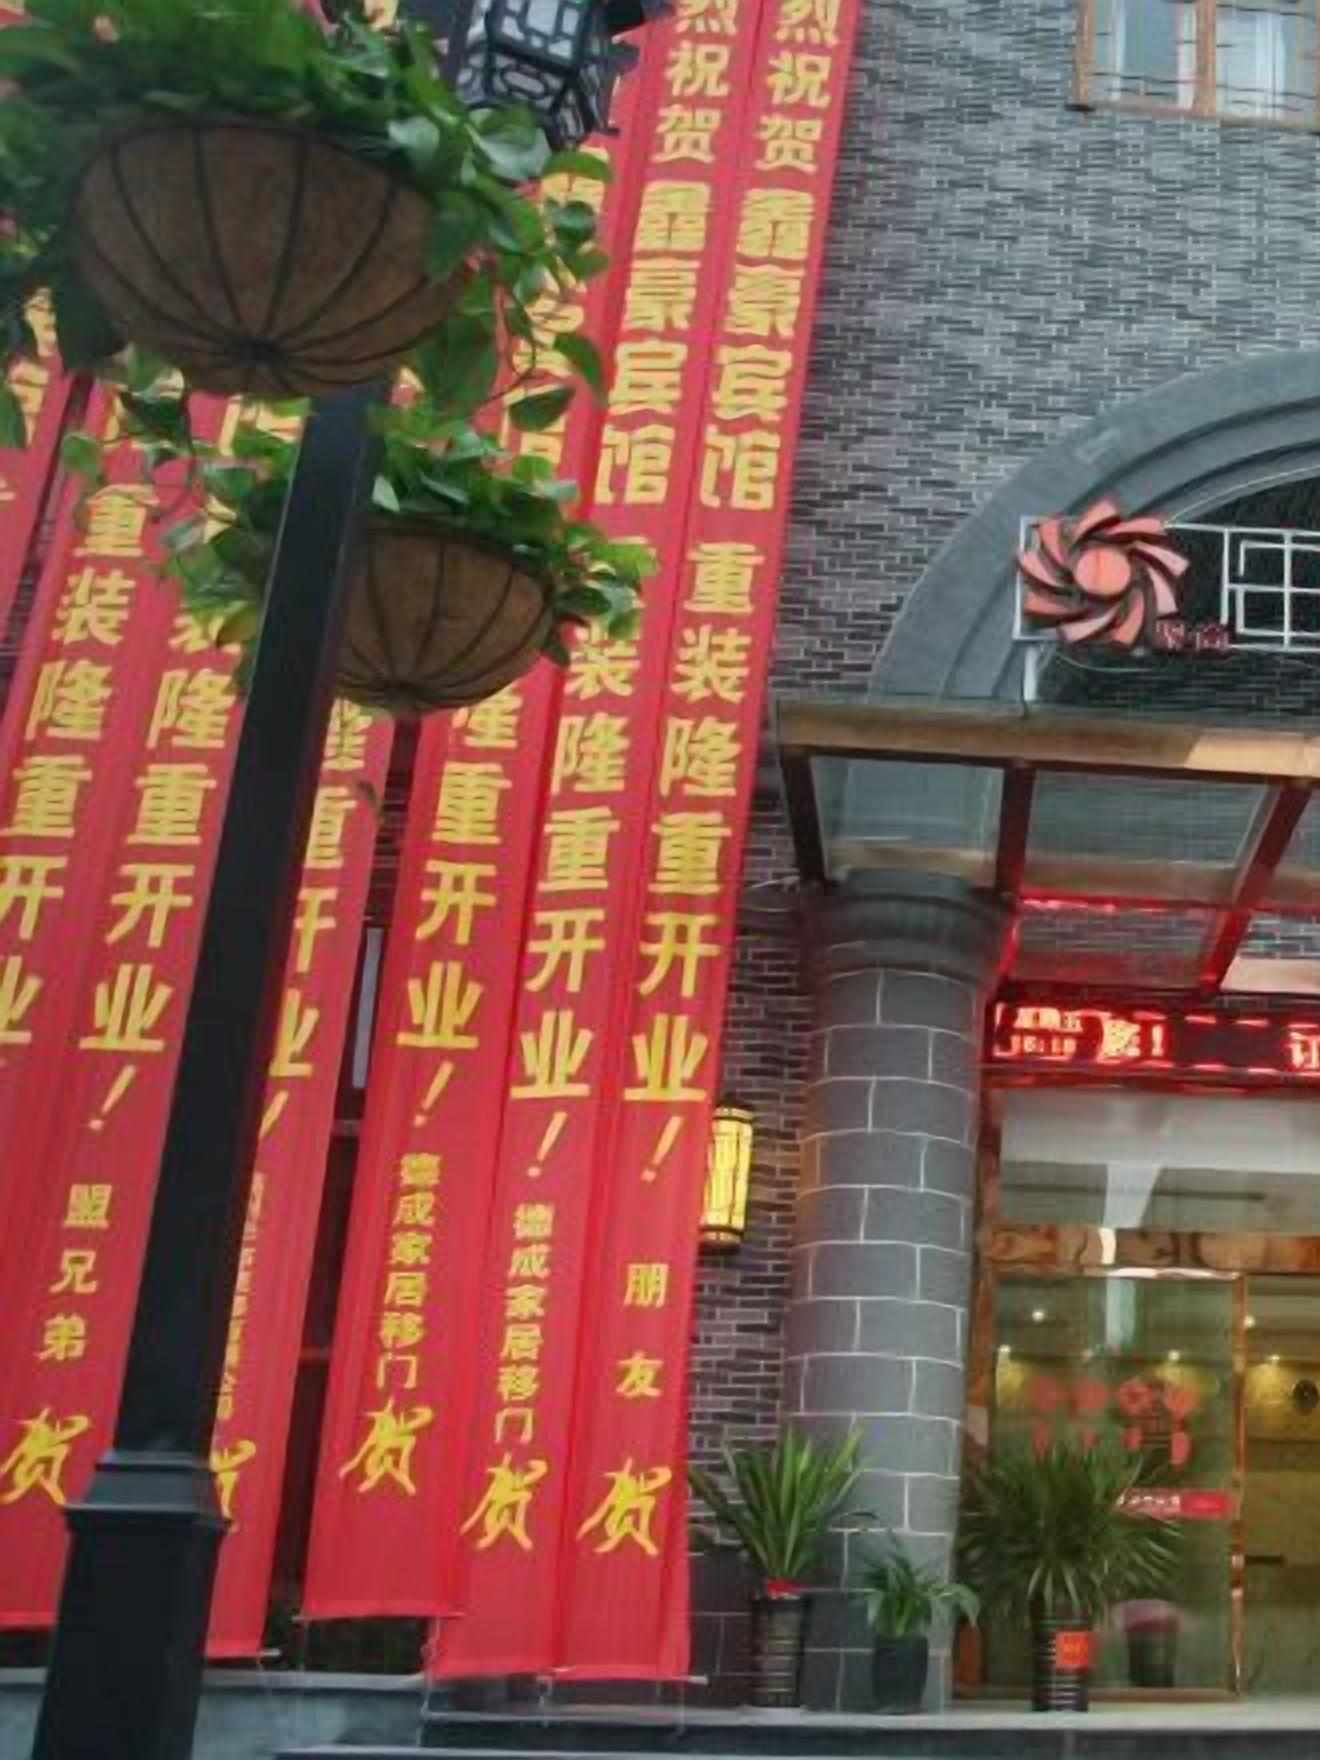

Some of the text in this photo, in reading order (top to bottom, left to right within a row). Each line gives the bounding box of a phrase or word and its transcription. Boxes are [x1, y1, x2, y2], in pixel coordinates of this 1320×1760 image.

[511, 536, 656, 1176] 装隆重开业！
[617, 1263, 668, 1397] 朋友
